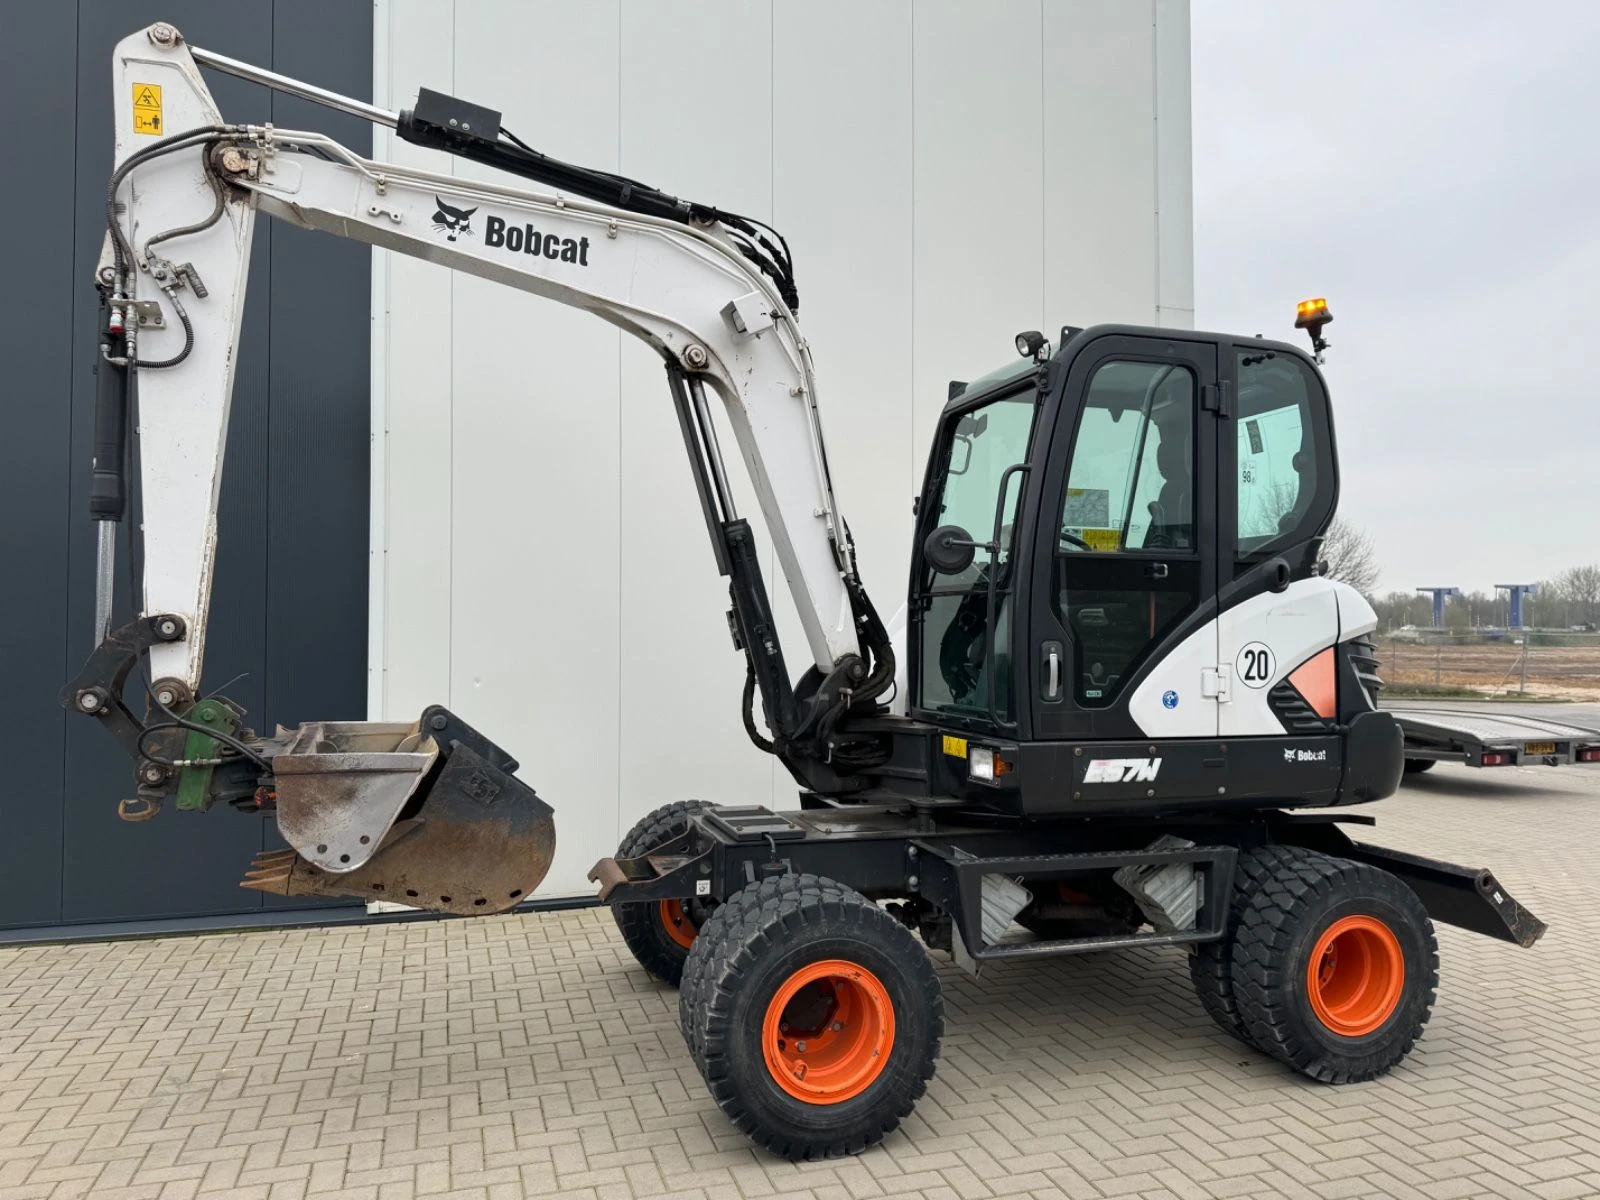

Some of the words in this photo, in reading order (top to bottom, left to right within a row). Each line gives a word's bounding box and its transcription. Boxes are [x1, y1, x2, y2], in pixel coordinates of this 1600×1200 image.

[485, 215, 589, 266] Bobcat
[1242, 470, 1251, 483] 98
[1244, 649, 1268, 680] 20
[1298, 749, 1326, 761] Bobcat
